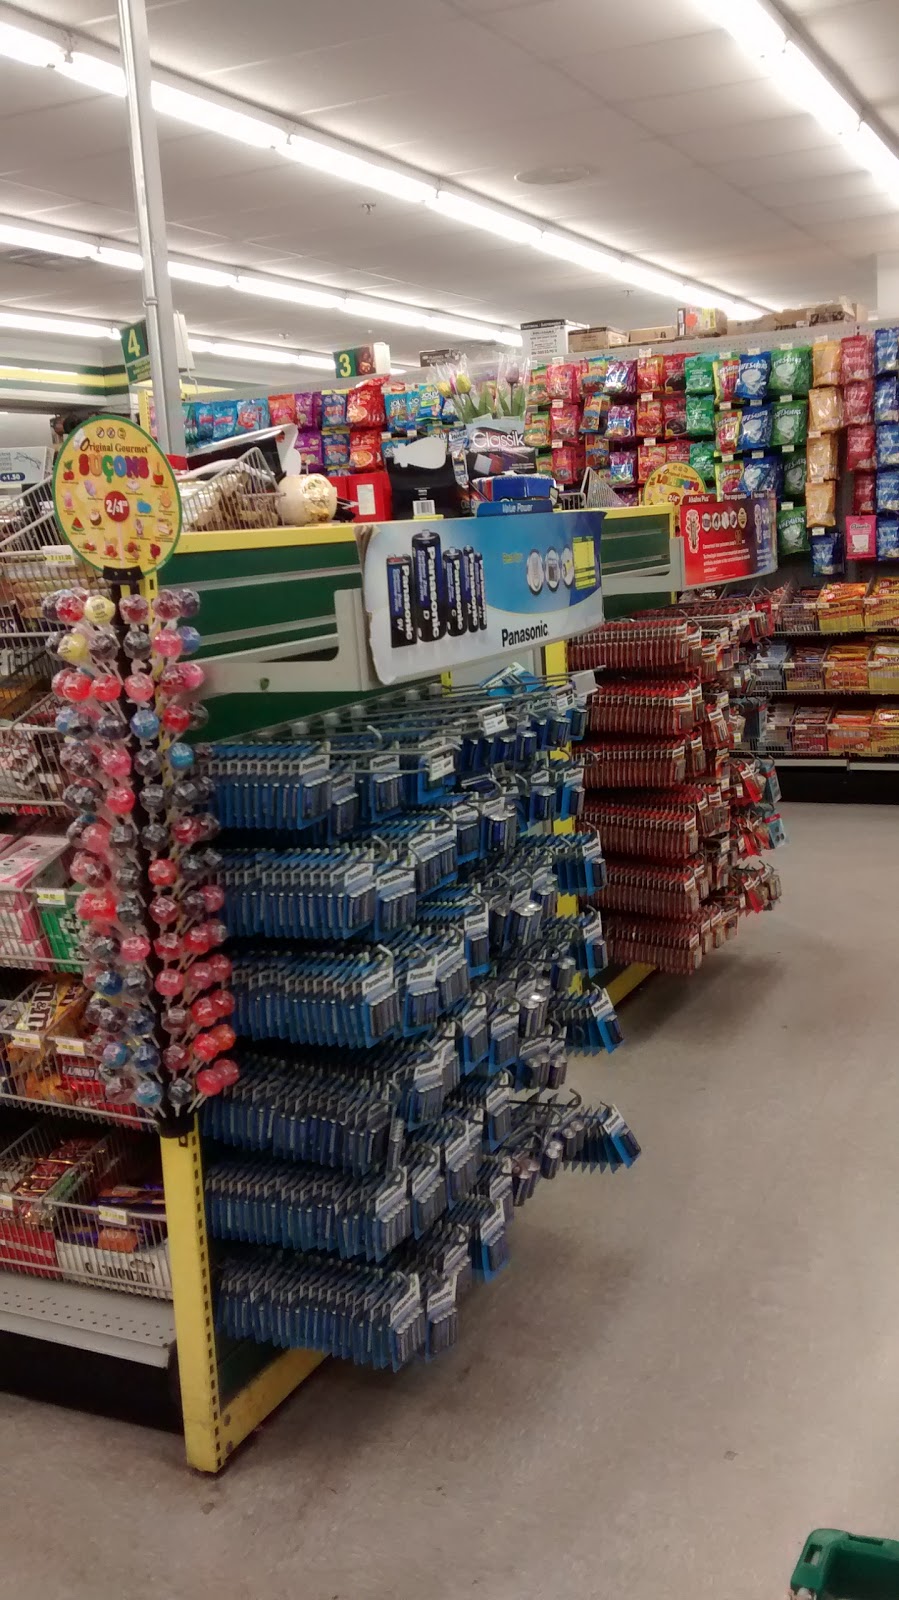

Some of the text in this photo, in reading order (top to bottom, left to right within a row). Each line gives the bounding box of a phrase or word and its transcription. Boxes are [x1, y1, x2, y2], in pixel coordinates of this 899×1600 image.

[128, 329, 140, 357] 4
[339, 353, 351, 377] 3
[80, 437, 149, 453] Original Gourmet
[472, 431, 526, 448] Classik
[79, 453, 150, 483] SUÇONS
[516, 502, 534, 512] Power
[402, 565, 413, 640] Panasonic
[427, 546, 440, 638] Panasonic
[453, 559, 464, 630] Panasonic
[469, 553, 478, 627] Panasonic
[397, 618, 404, 631] 9V
[423, 610, 430, 620] D
[501, 619, 549, 648] Panasonic
